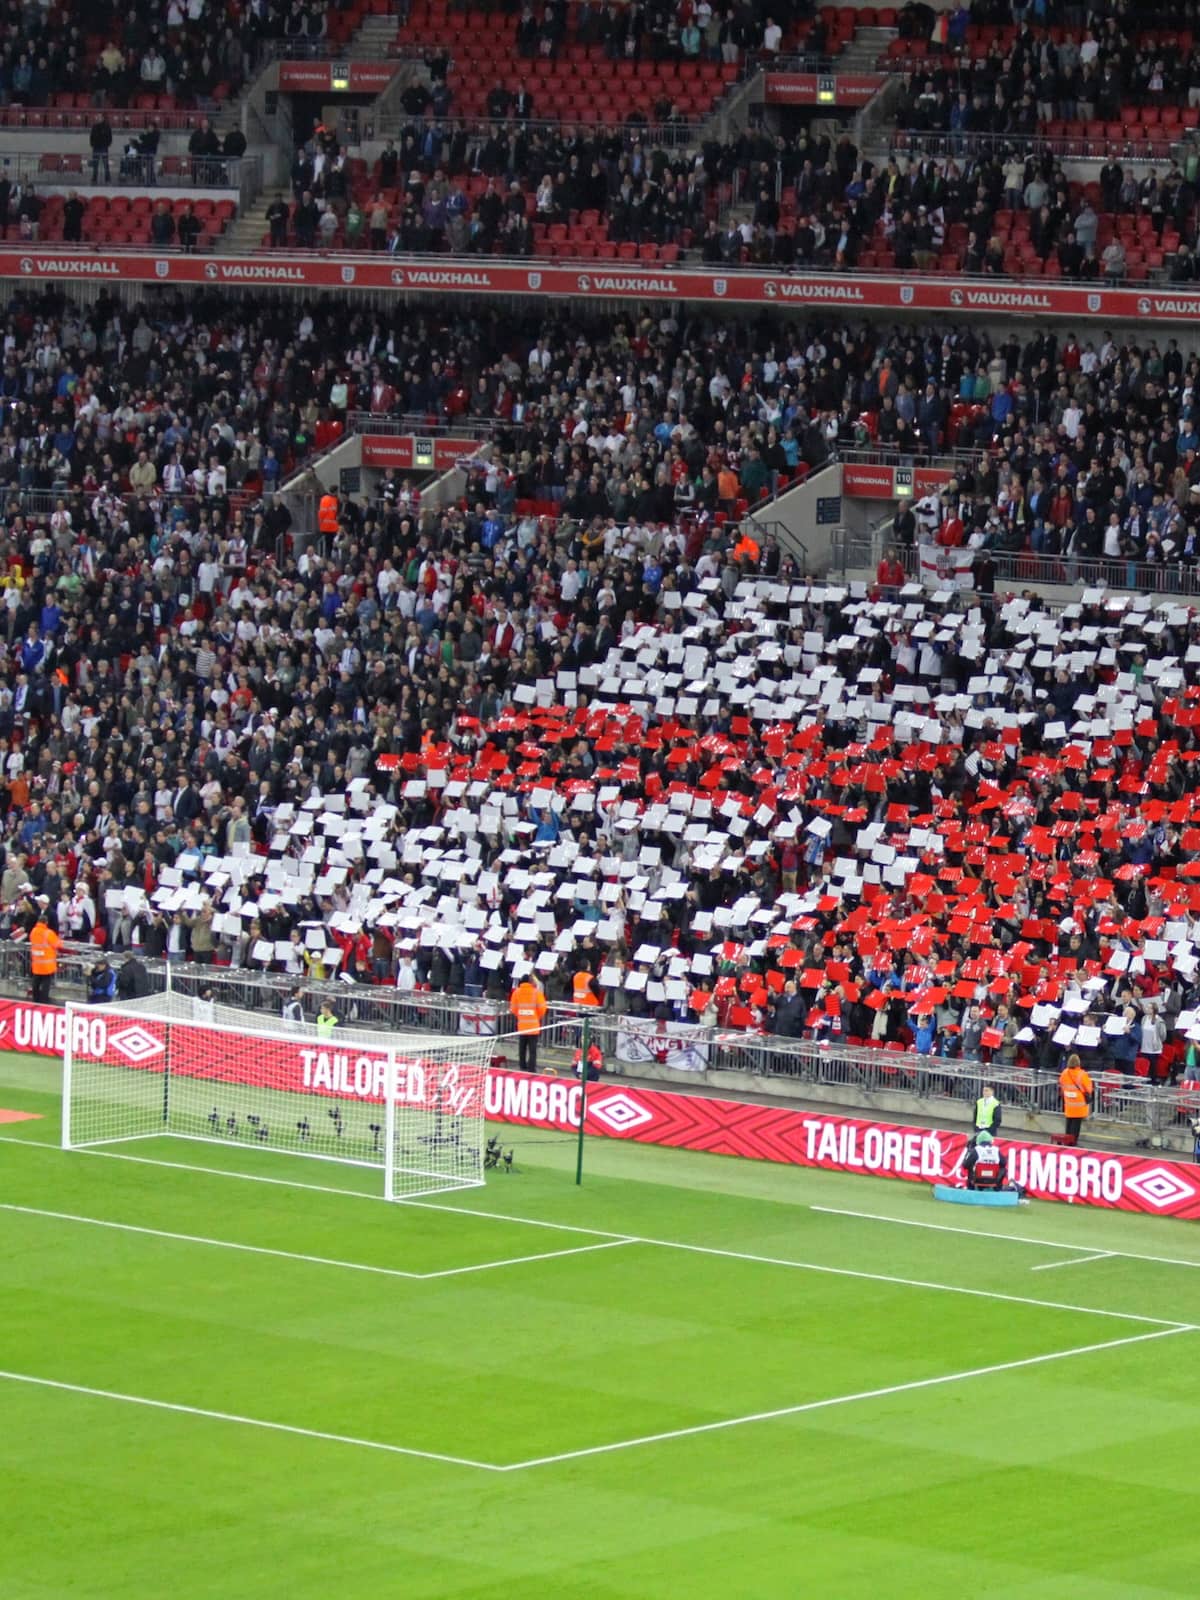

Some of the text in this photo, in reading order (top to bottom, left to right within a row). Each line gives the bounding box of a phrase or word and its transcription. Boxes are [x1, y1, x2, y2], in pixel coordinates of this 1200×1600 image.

[333, 68, 348, 78] 210
[820, 82, 834, 91] 211
[37, 261, 120, 274] VAUXHALL
[222, 264, 305, 279] VAUXHALL
[407, 270, 490, 285] VAUXHALL
[594, 277, 678, 292] VAUXHALL
[780, 284, 864, 299] VAUXHALL
[967, 292, 1051, 307] VAUXHALL
[417, 443, 431, 454] 109
[853, 476, 891, 487] VAUXHALL
[897, 473, 911, 483] 110
[14, 1007, 107, 1057] UMBRO
[300, 1050, 424, 1103] TAILORED
[485, 1075, 587, 1127] UMBRO
[803, 1120, 941, 1178] TAILORED
[1008, 1148, 1123, 1202] UMBRO
